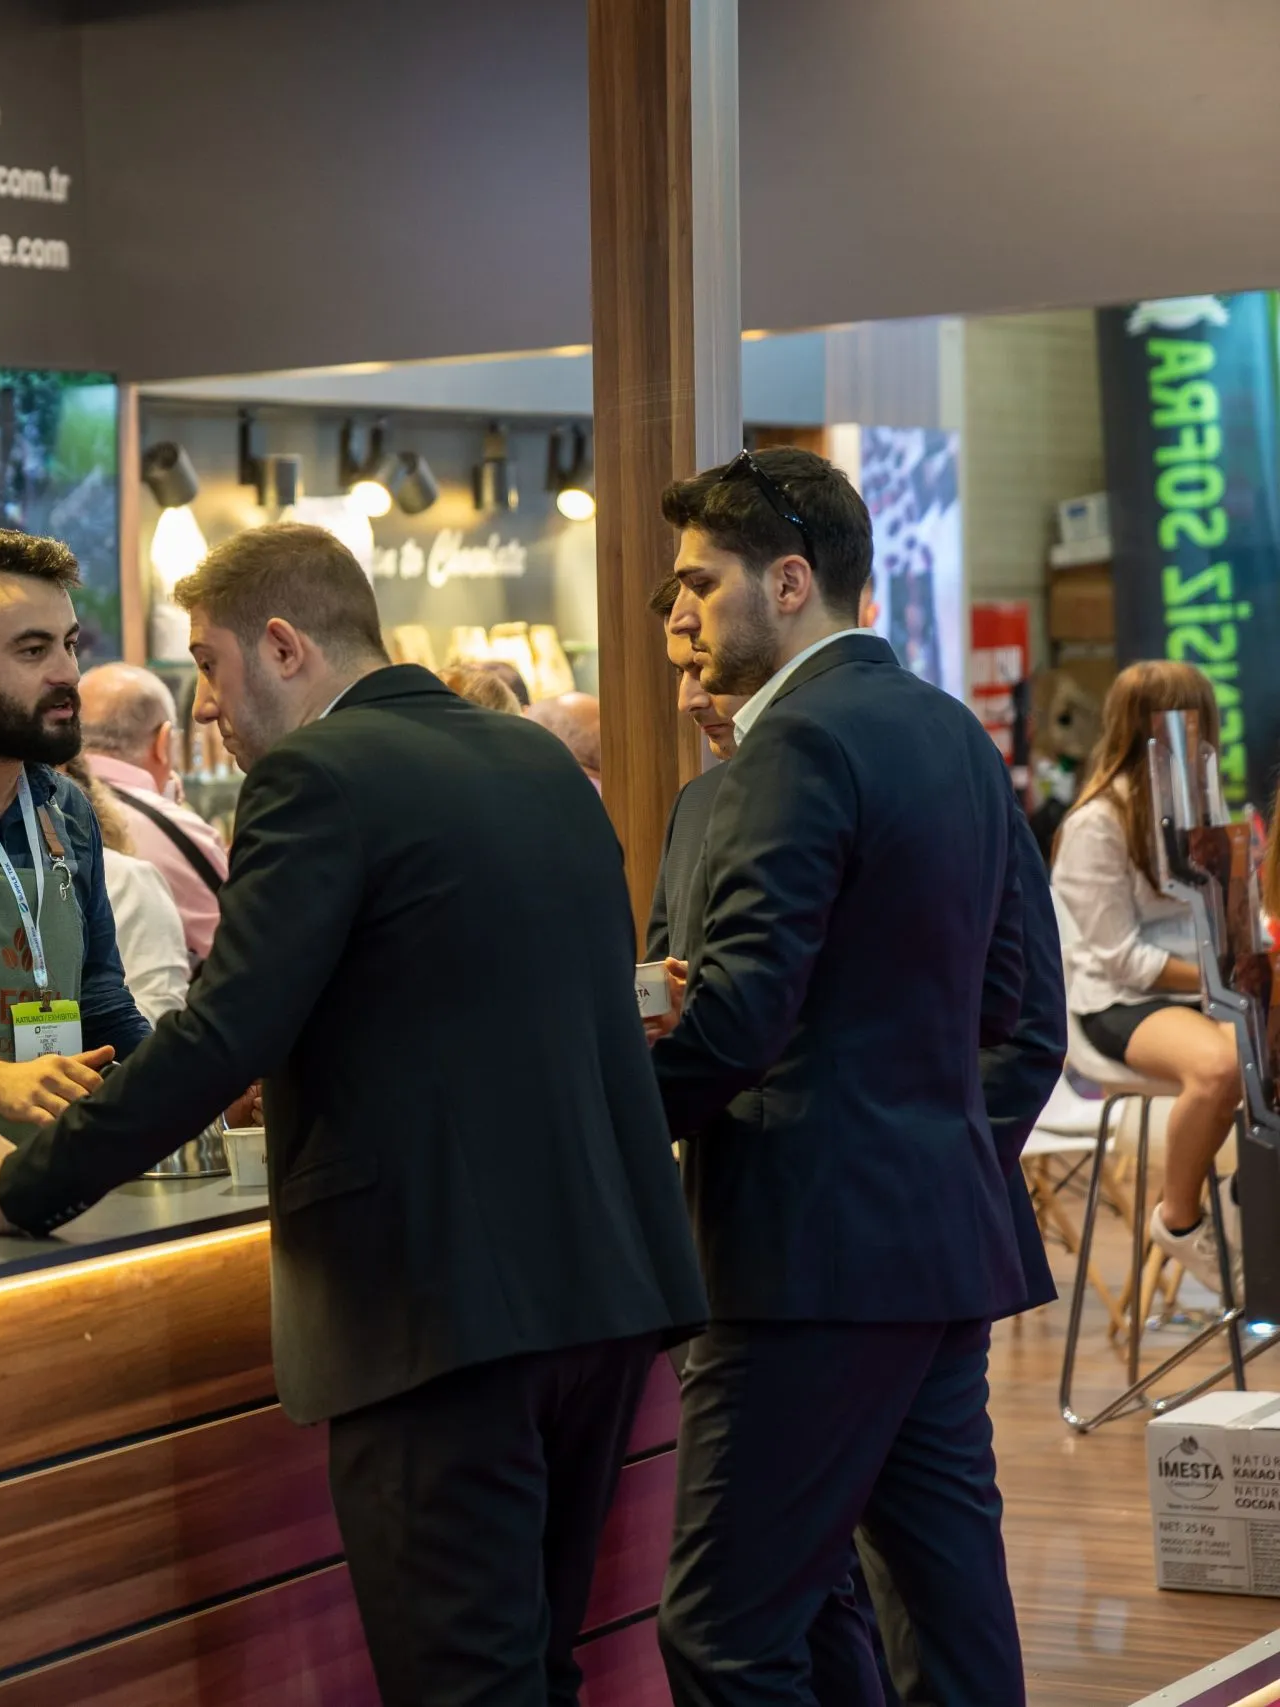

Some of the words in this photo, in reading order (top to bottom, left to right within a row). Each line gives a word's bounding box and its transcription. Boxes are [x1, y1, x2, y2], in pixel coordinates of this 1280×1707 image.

[1158, 1457, 1224, 1480] İMESTA
[1233, 1467, 1275, 1480] KAKAO
[1235, 1498, 1275, 1510] COCOA
